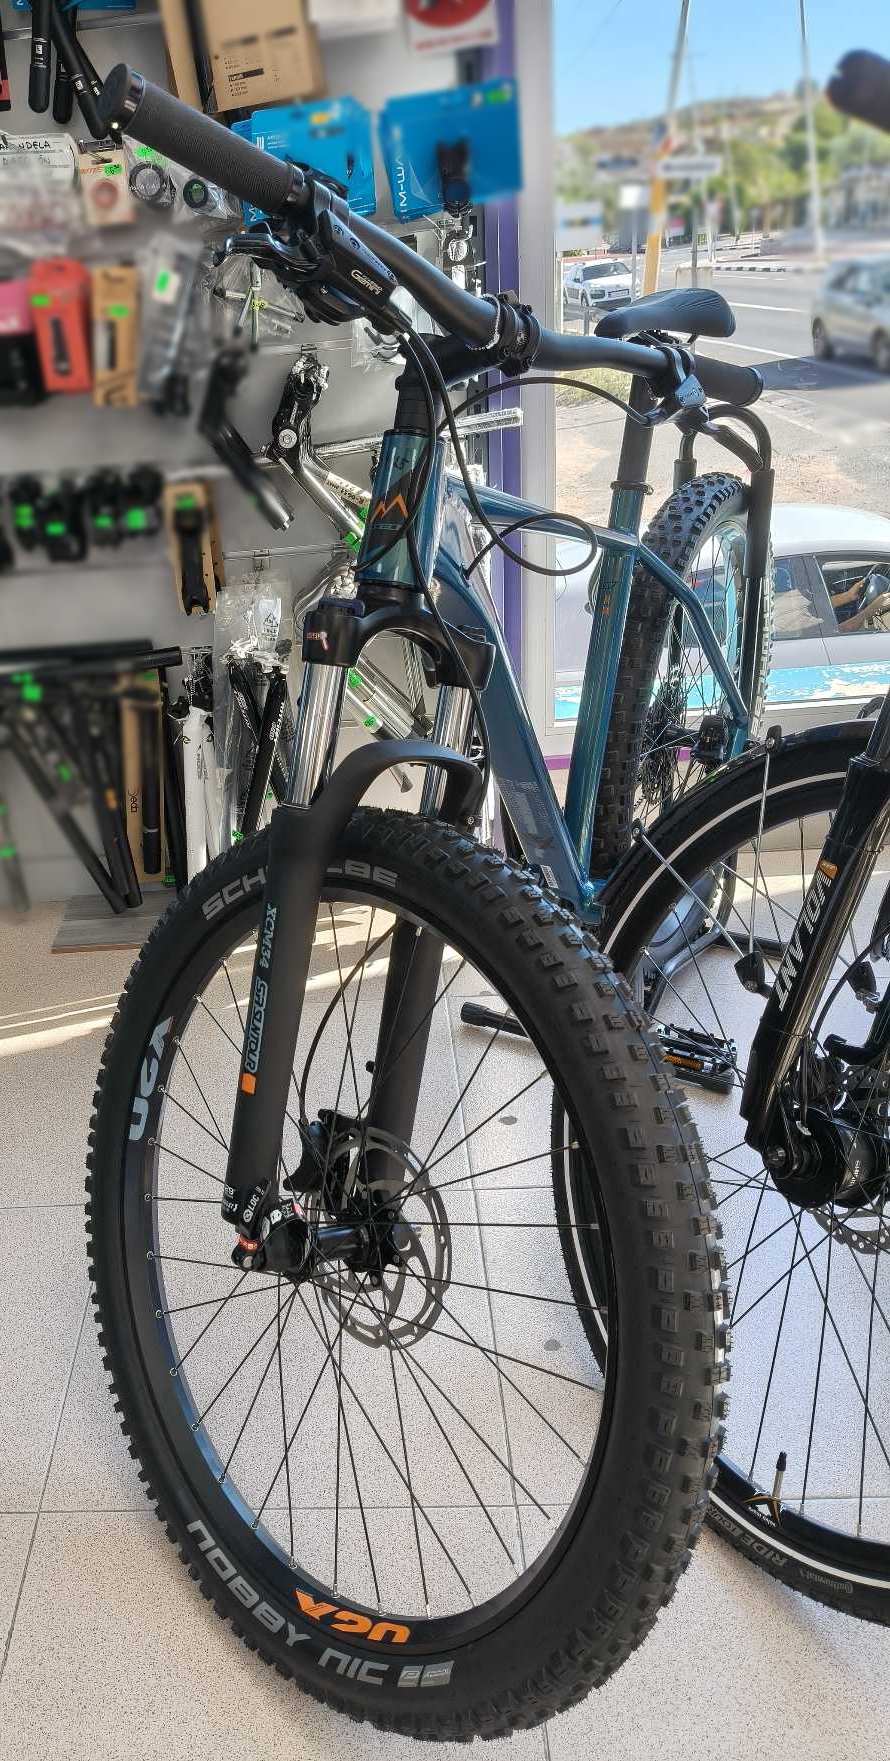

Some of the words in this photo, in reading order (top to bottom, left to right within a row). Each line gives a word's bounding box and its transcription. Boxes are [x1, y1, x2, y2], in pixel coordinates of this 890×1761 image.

[259, 902, 277, 969] XCM34
[741, 1533, 789, 1568] RIDE
[318, 1647, 390, 1686] NIC
